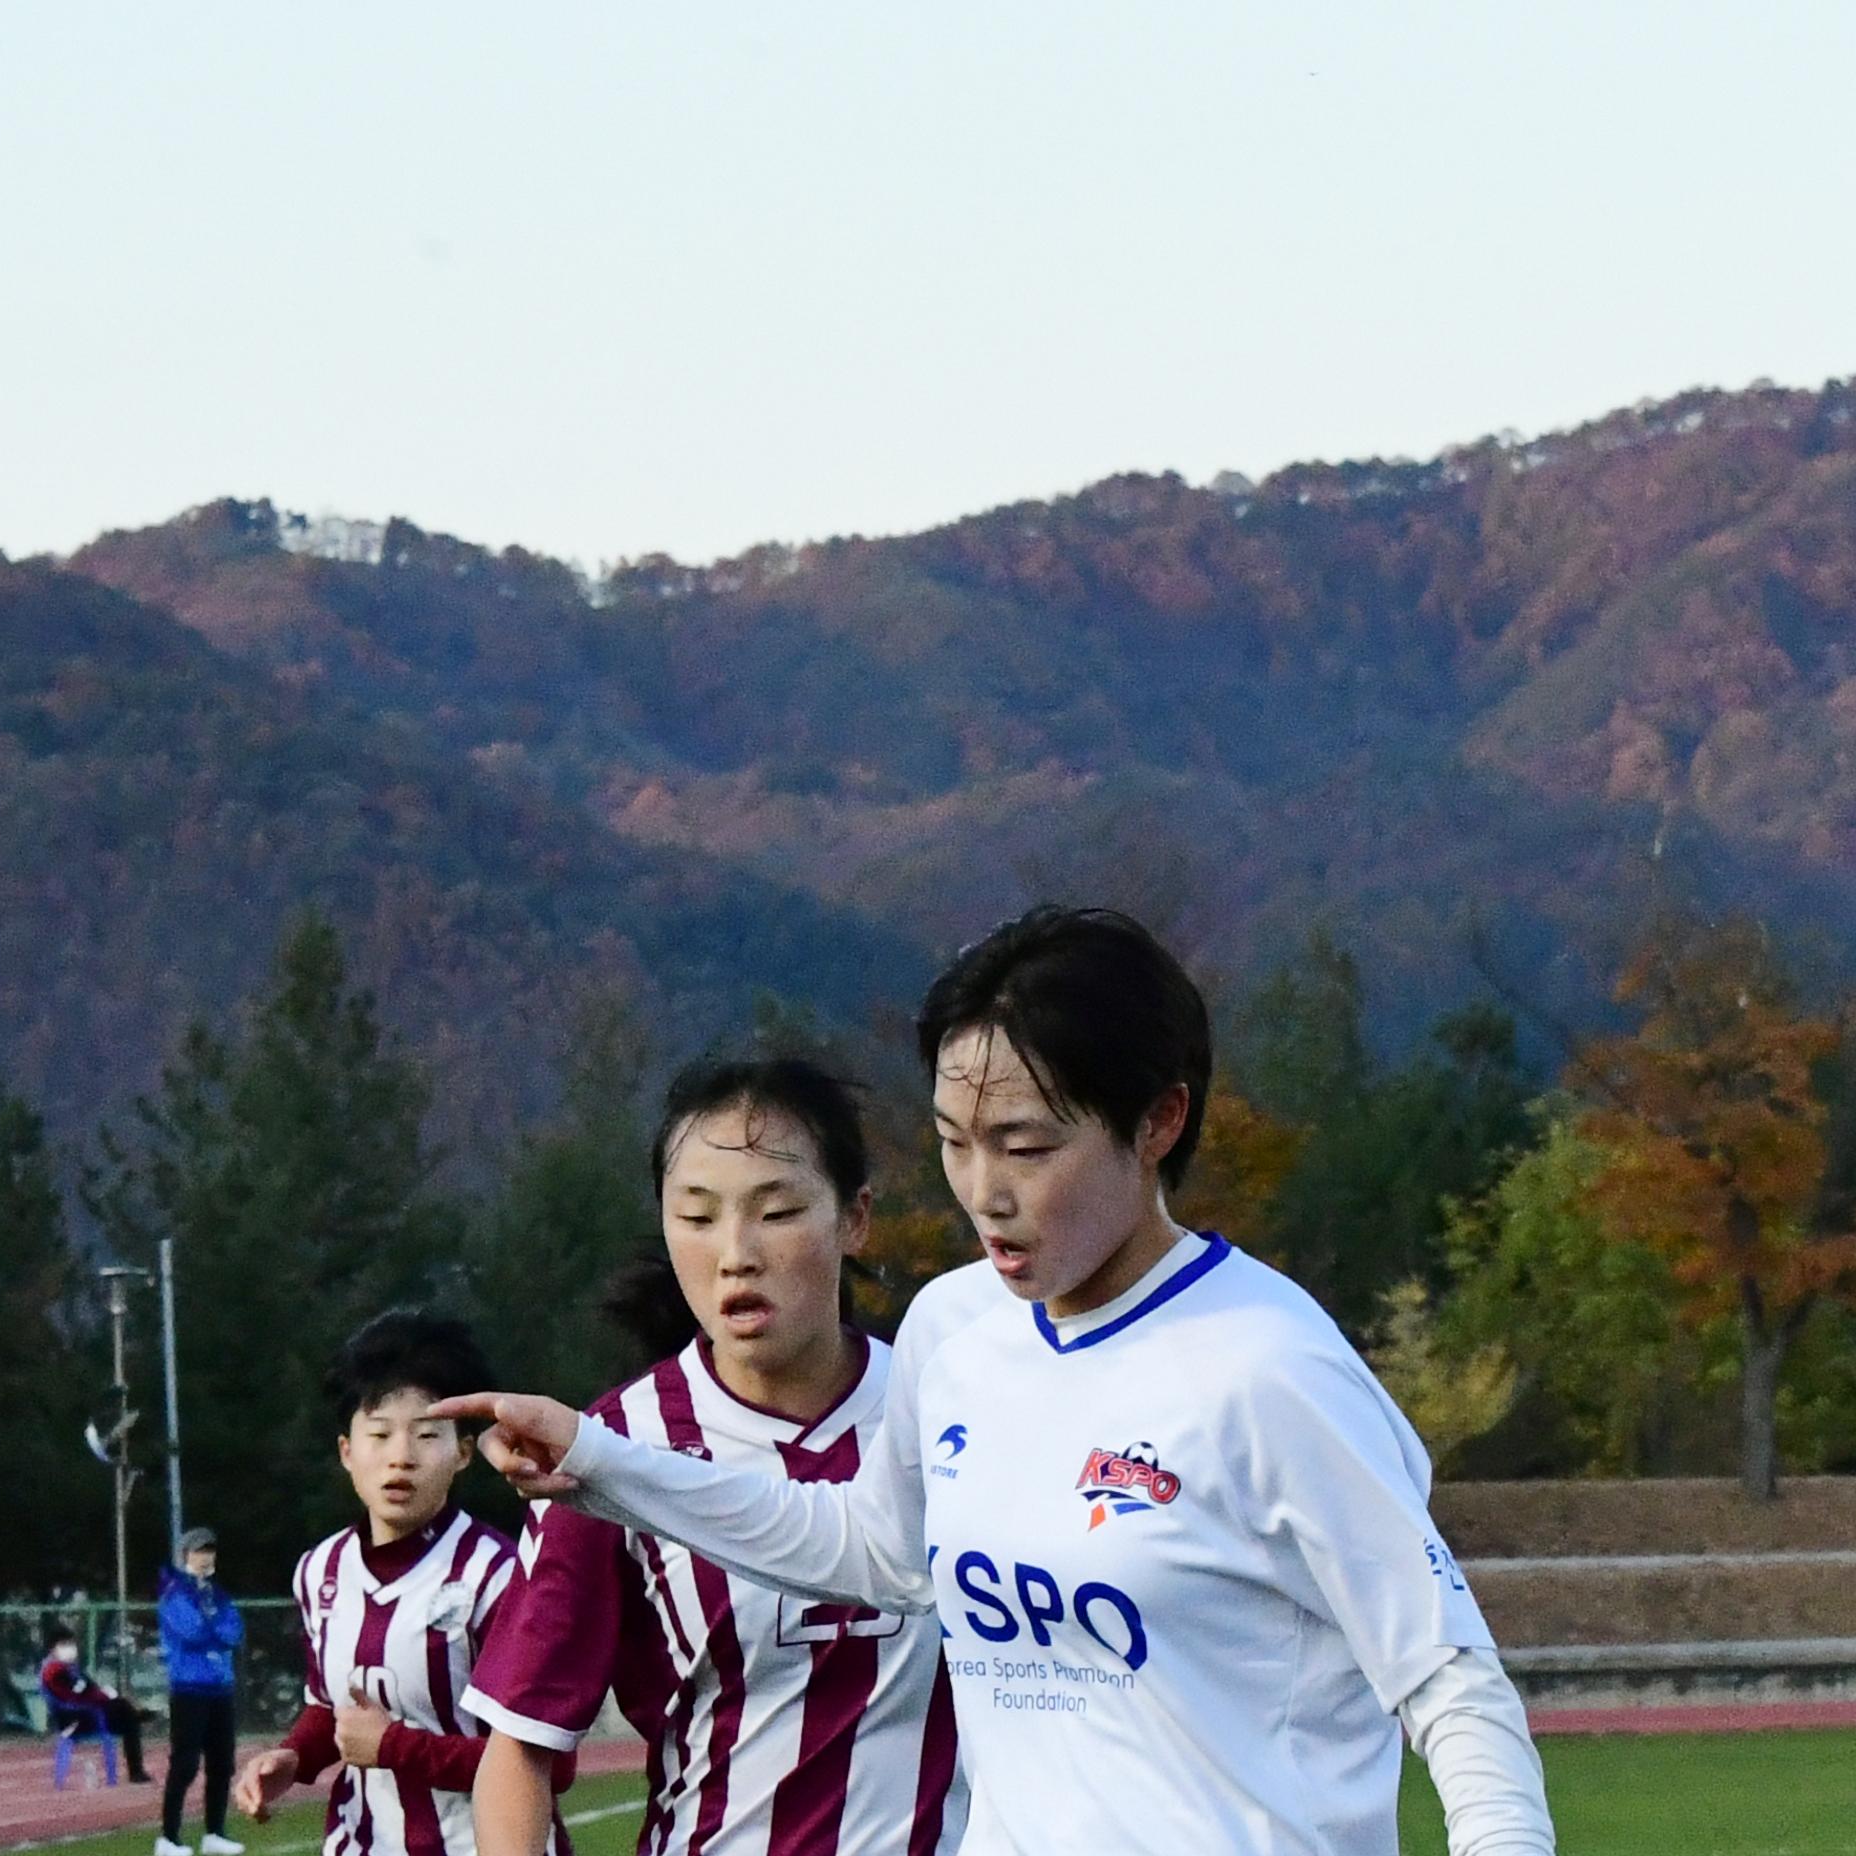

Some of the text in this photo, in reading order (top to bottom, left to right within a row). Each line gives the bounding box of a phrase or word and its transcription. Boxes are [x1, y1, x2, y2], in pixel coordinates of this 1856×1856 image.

[1075, 1448, 1181, 1504] KSPO
[993, 1657, 1047, 1683] Sports
[994, 1688, 1087, 1712] Foundation
